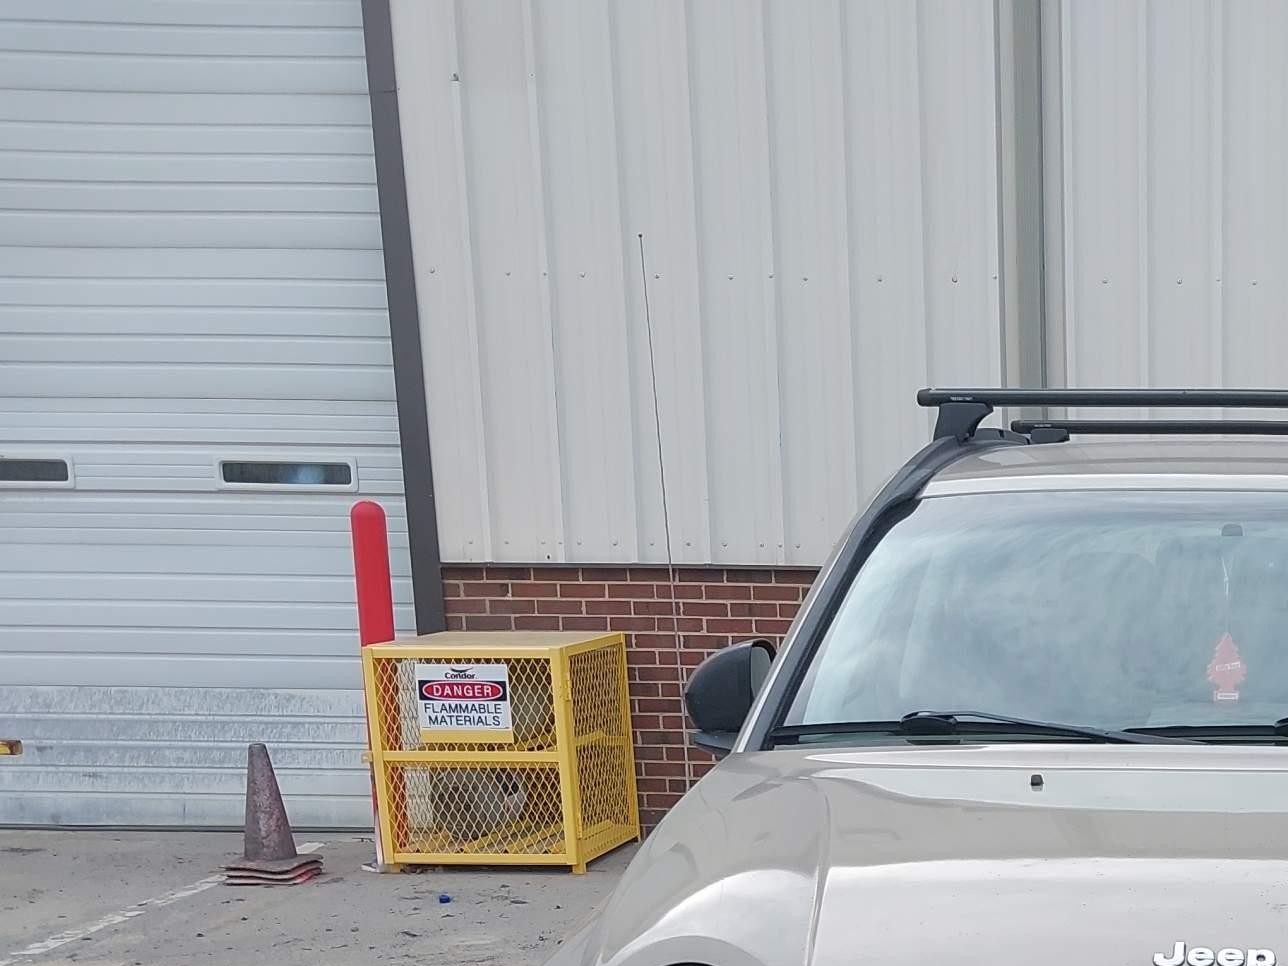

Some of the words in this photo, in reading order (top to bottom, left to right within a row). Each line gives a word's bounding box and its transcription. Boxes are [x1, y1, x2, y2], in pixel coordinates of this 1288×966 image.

[444, 672, 476, 680] Condor
[433, 685, 492, 697] DANGER
[424, 703, 502, 714] FLAMMABLE
[428, 715, 501, 727] MATERIALS
